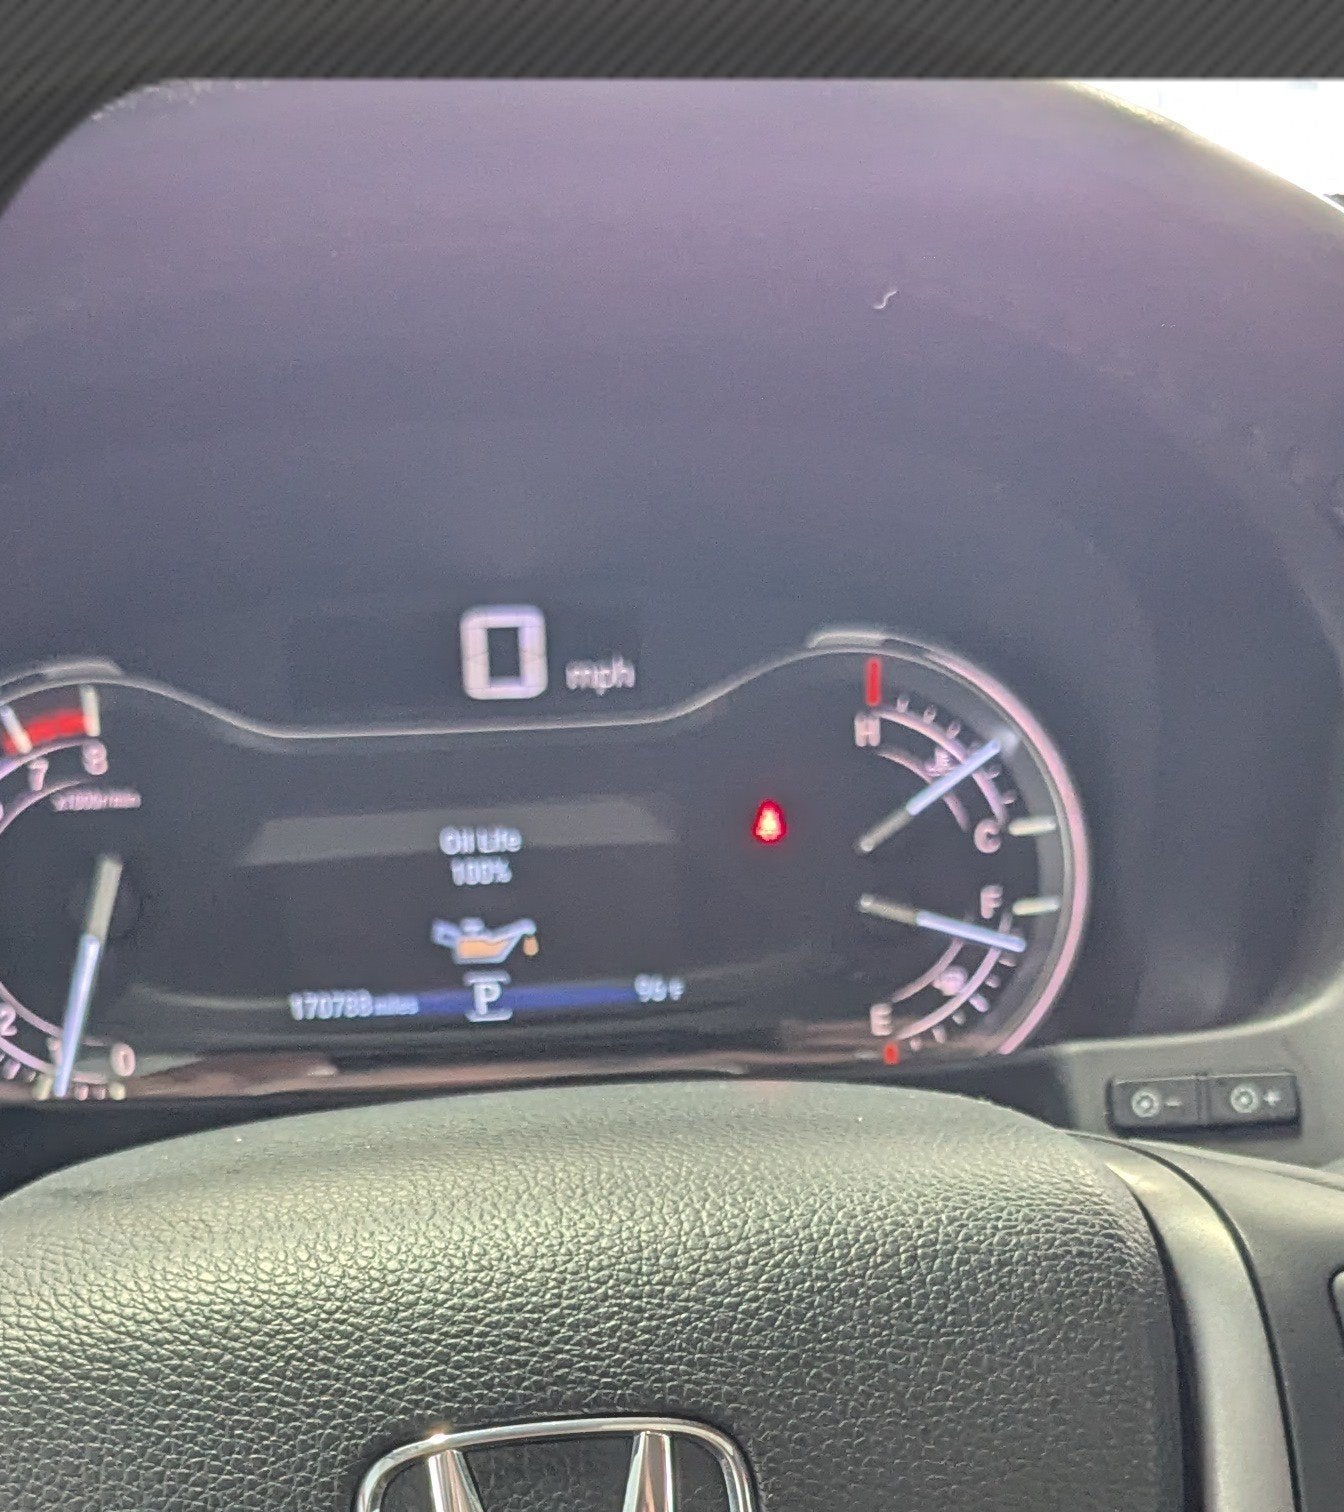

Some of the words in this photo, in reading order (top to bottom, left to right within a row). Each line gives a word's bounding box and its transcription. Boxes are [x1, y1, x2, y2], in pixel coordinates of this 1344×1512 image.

[460, 605, 548, 699] 0
[566, 655, 636, 695] mph
[472, 982, 502, 1014] P
[109, 1042, 137, 1078] 0
